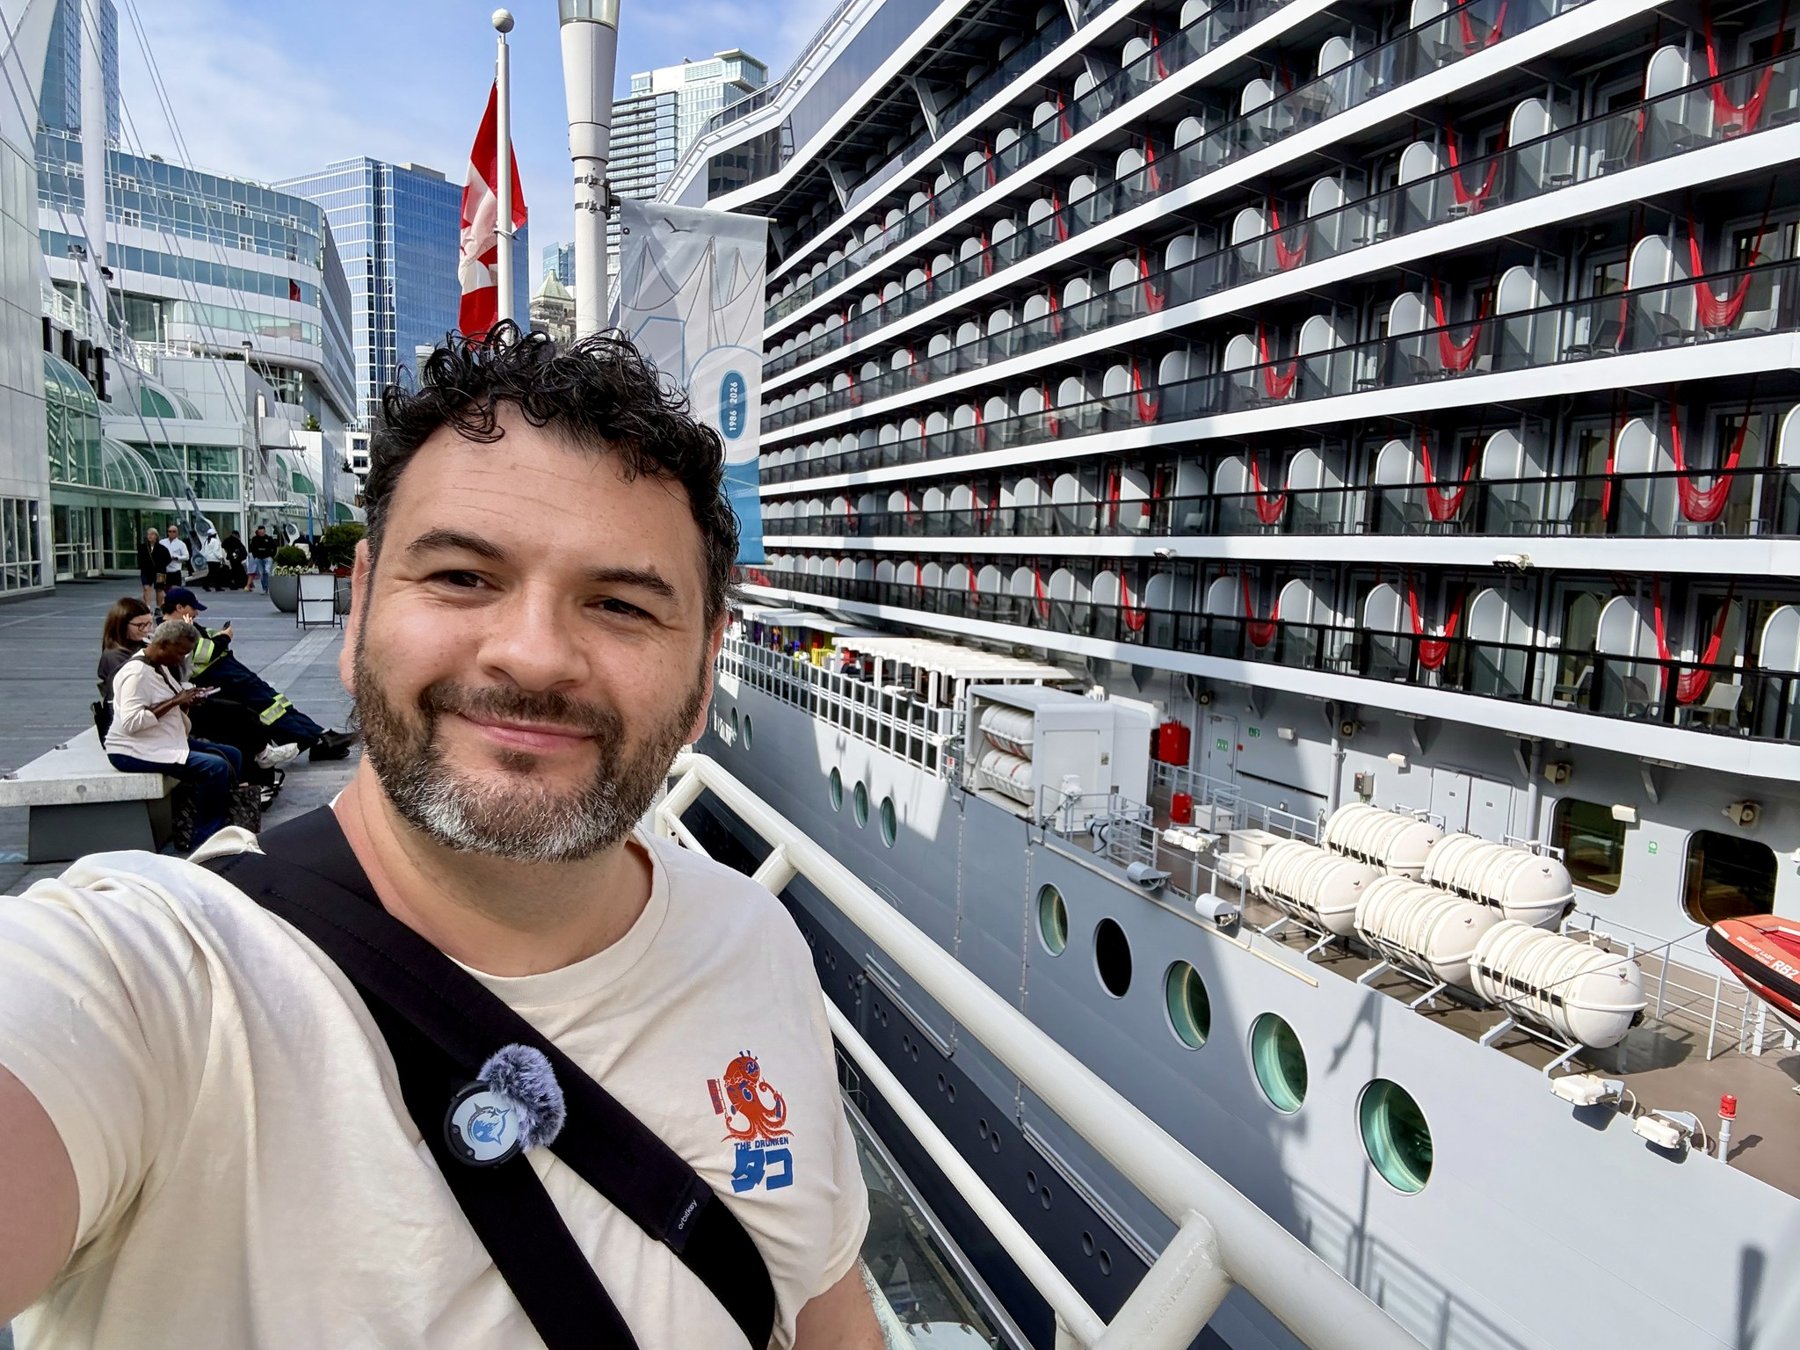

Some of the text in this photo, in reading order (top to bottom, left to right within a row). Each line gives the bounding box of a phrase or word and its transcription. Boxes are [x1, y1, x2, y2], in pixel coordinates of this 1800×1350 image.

[729, 381, 738, 431] 1986 2026
[1771, 959, 1799, 979] RB2
[734, 1136, 789, 1151] THE DRUNKEN
[730, 1147, 794, 1193] タコ
[678, 1199, 698, 1230] orbitkey
